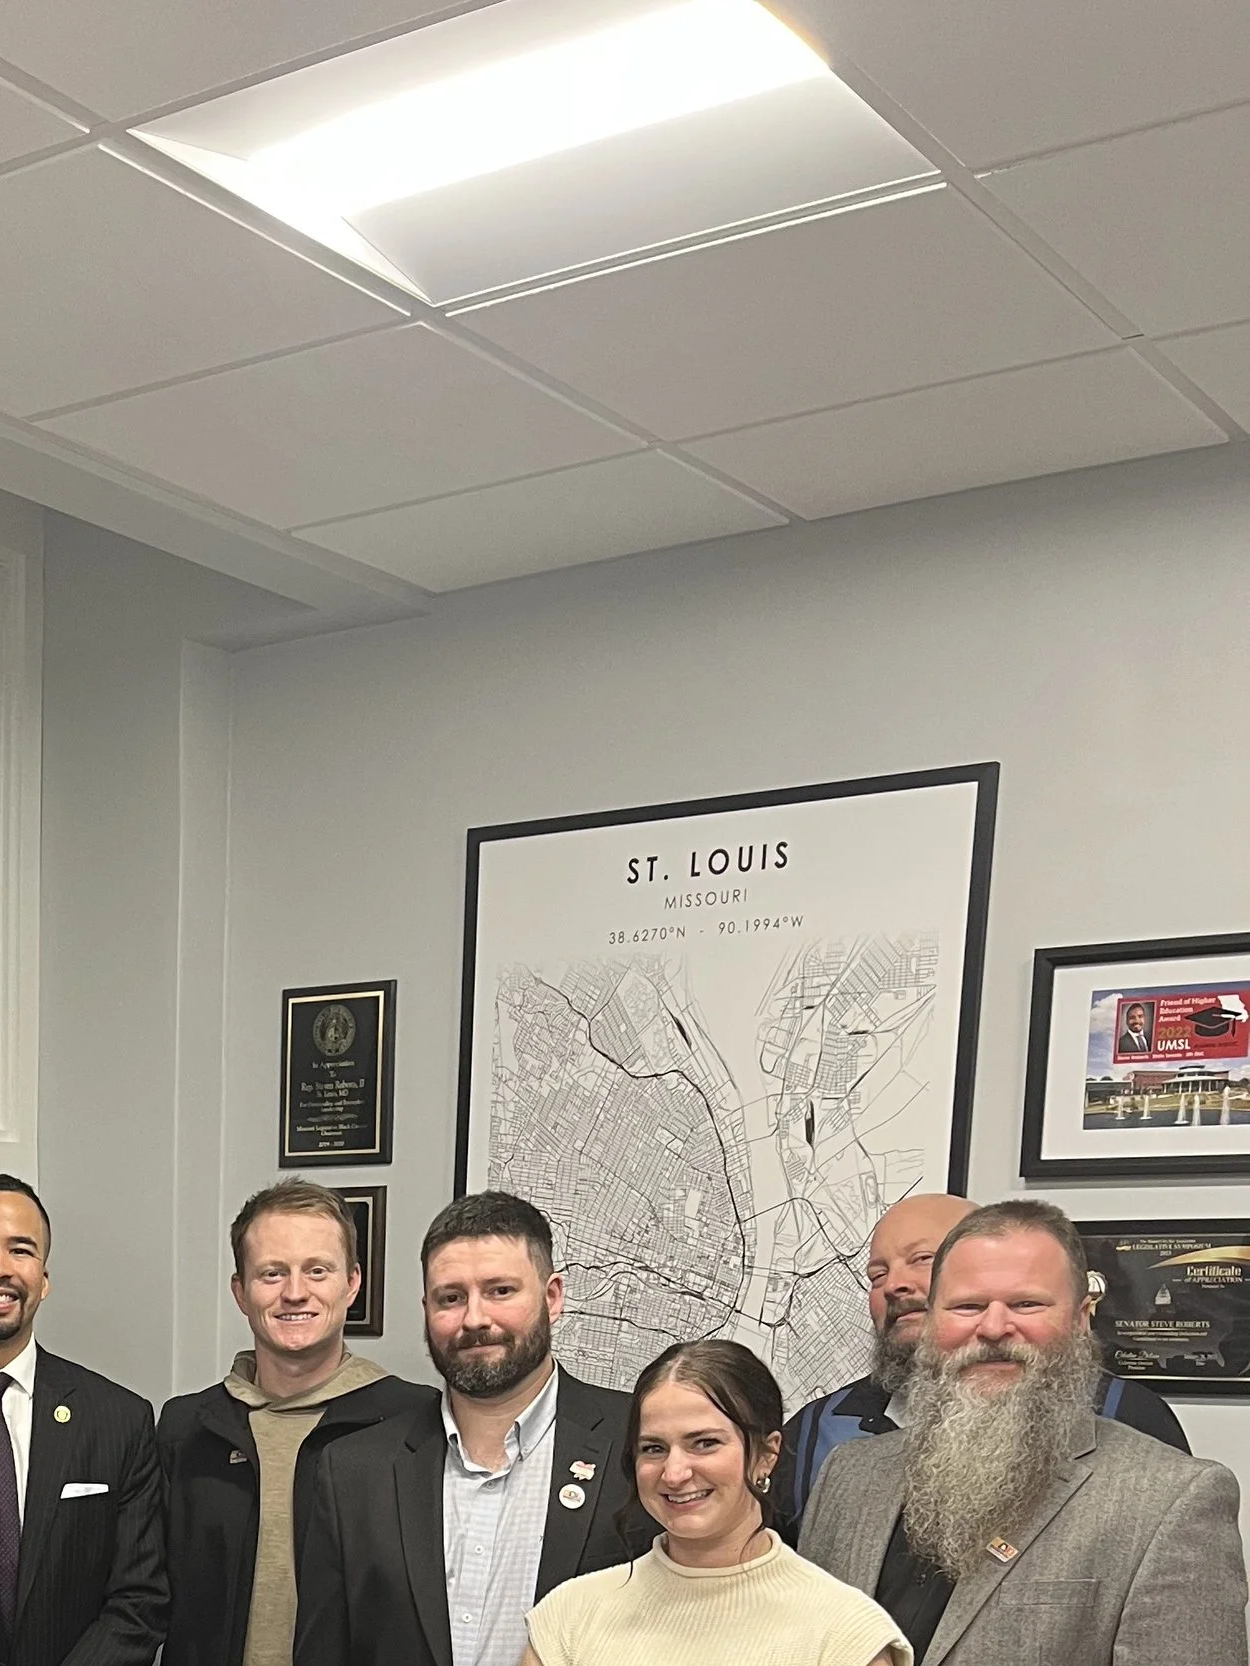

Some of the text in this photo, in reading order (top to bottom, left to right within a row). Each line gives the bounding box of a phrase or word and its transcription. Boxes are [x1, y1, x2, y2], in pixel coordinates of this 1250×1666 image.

[626, 841, 789, 885] ST. LOUIS
[663, 888, 748, 910] MISSOURI
[1158, 1026, 1192, 1039] 2022
[1157, 1039, 1191, 1051] UMSL
[1186, 1265, 1242, 1277] Certificate
[1115, 1320, 1211, 1329] SENATOR STEVE ROBERTS
